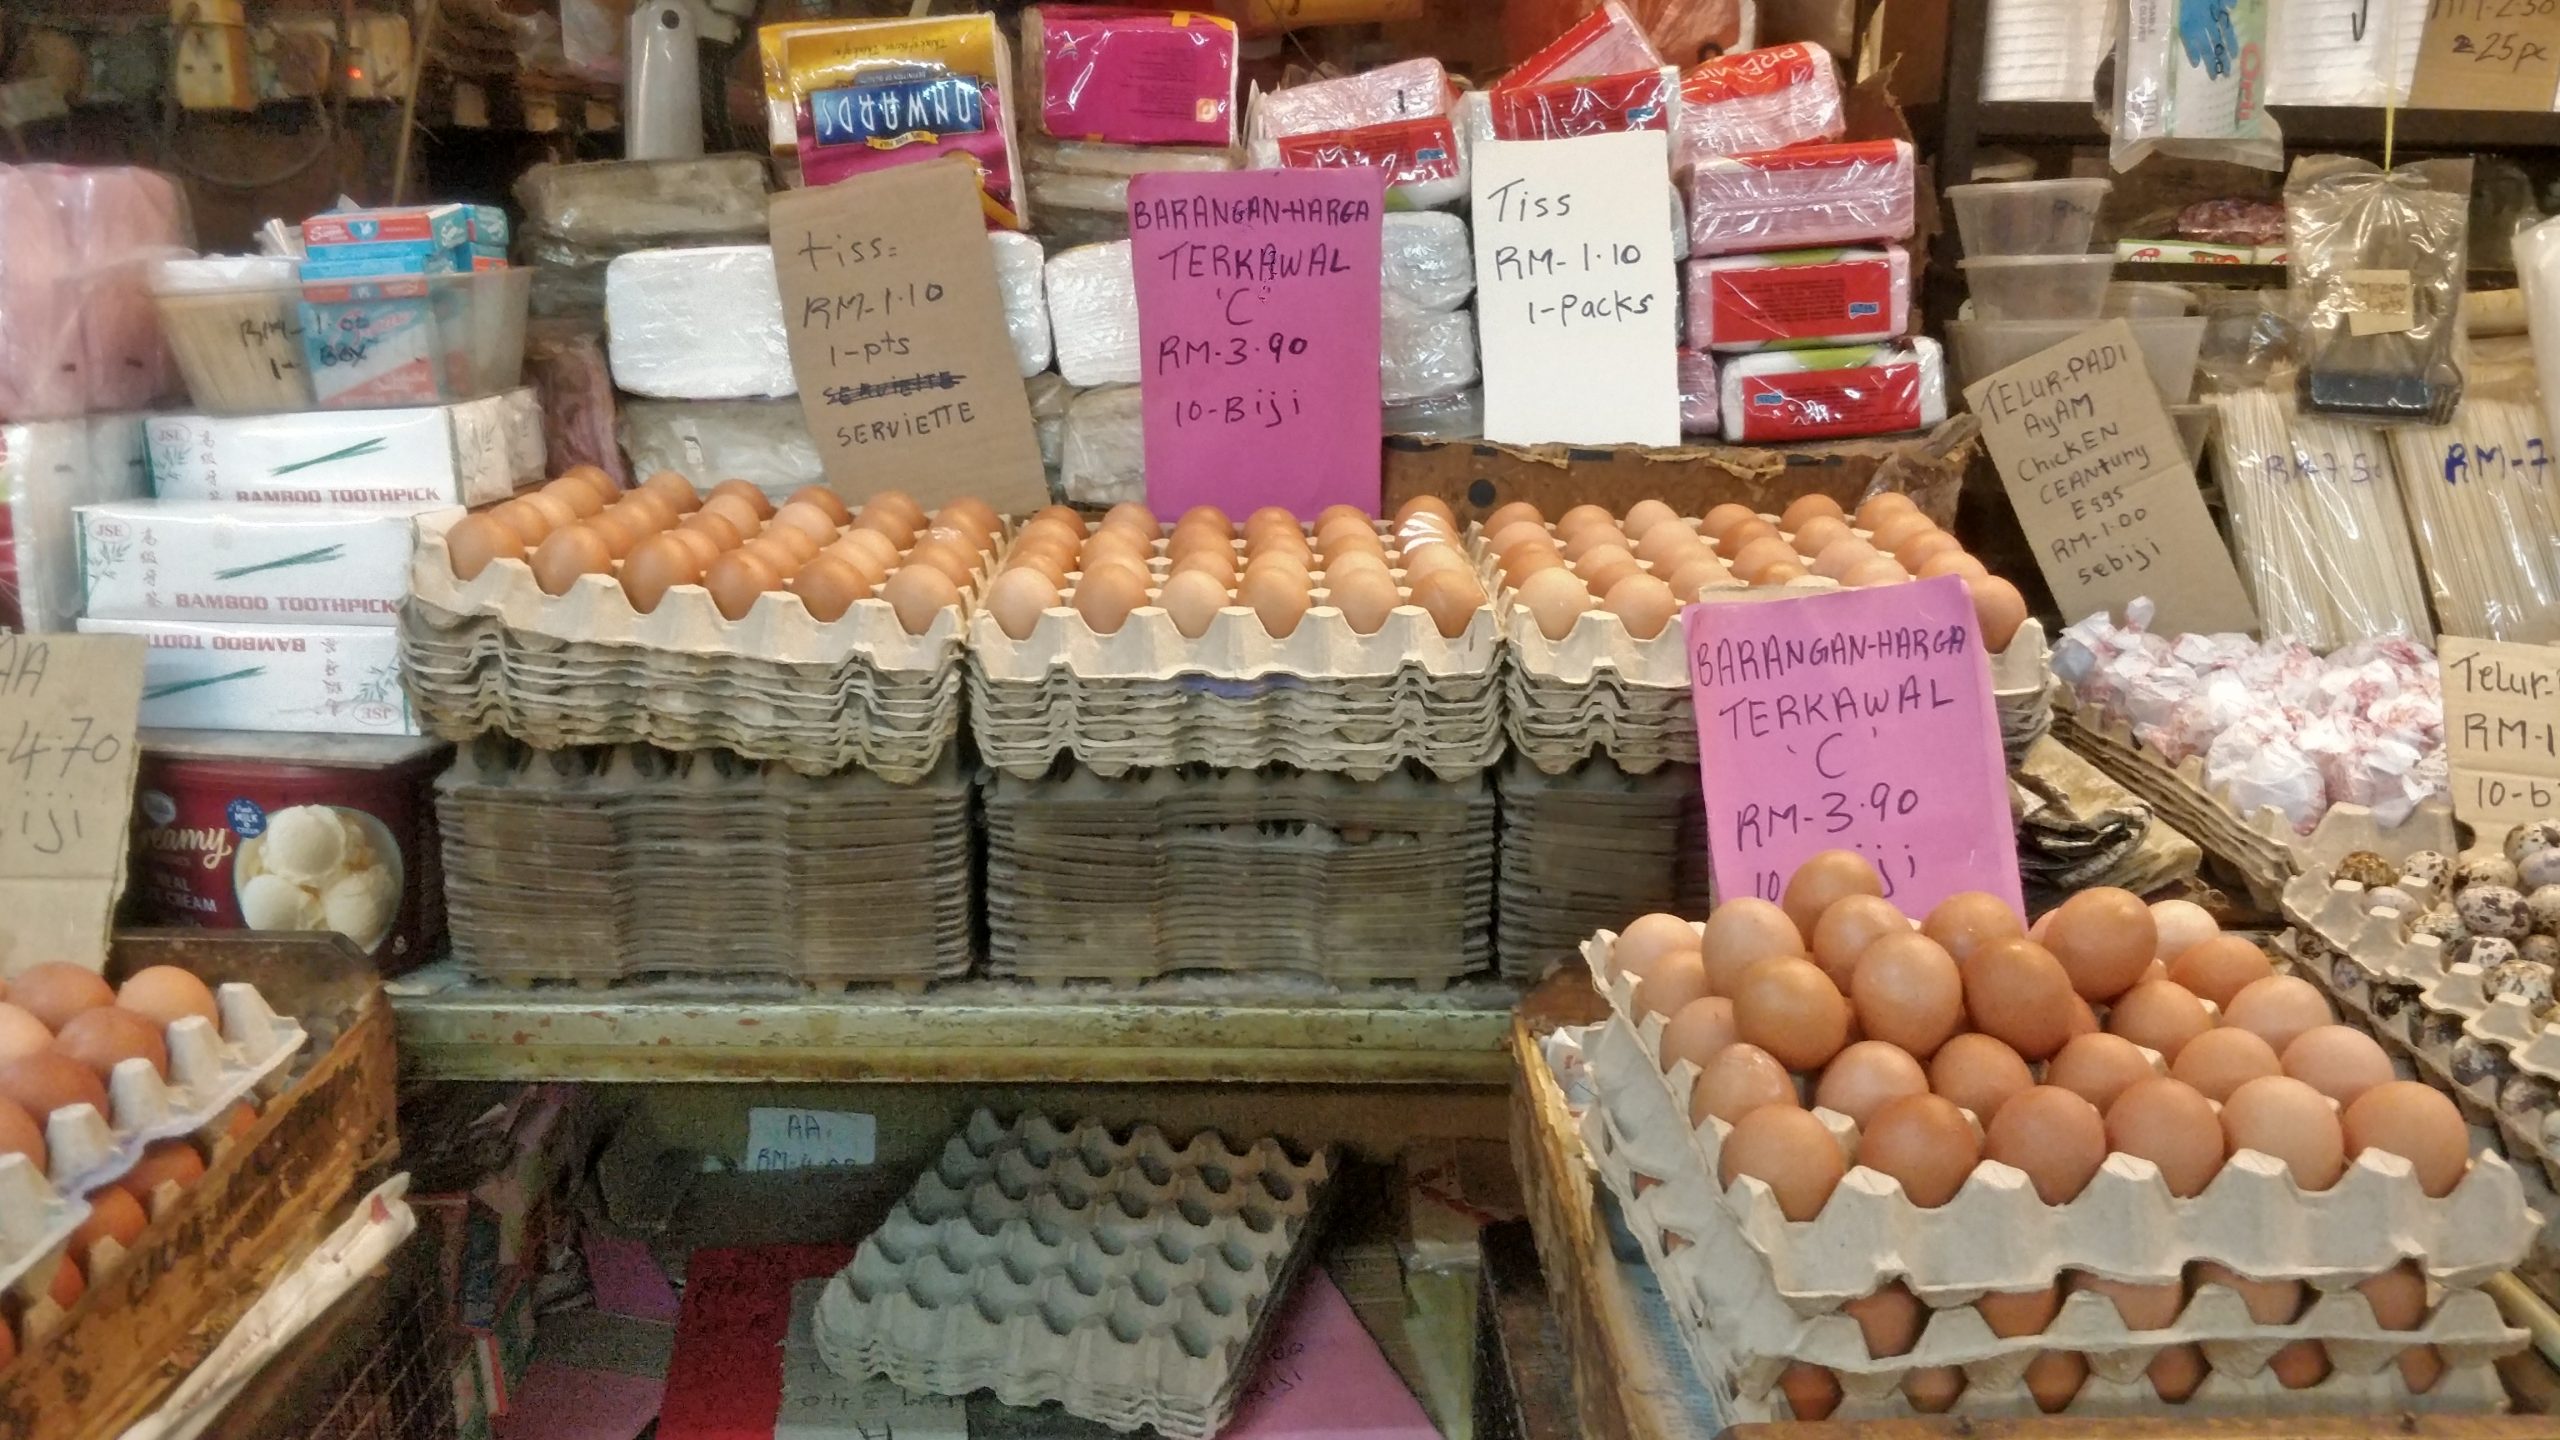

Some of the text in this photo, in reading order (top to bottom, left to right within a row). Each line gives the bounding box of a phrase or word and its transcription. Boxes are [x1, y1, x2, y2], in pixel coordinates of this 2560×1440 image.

[825, 82, 972, 136] ONWARDS
[1134, 196, 1370, 231] BARANGAN-HARGA
[1488, 178, 1571, 222] Tiss
[1158, 241, 1351, 282] TERKAWAL
[1980, 344, 2128, 425] TELUR-PADI
[97, 521, 123, 537] JSE
[175, 593, 399, 614] BAMBOO TOOTHPICK
[212, 637, 306, 652] BAMBOO
[1697, 625, 1967, 687] BARANGAN-HARGA
[1718, 674, 1955, 741] TERKAWAL
